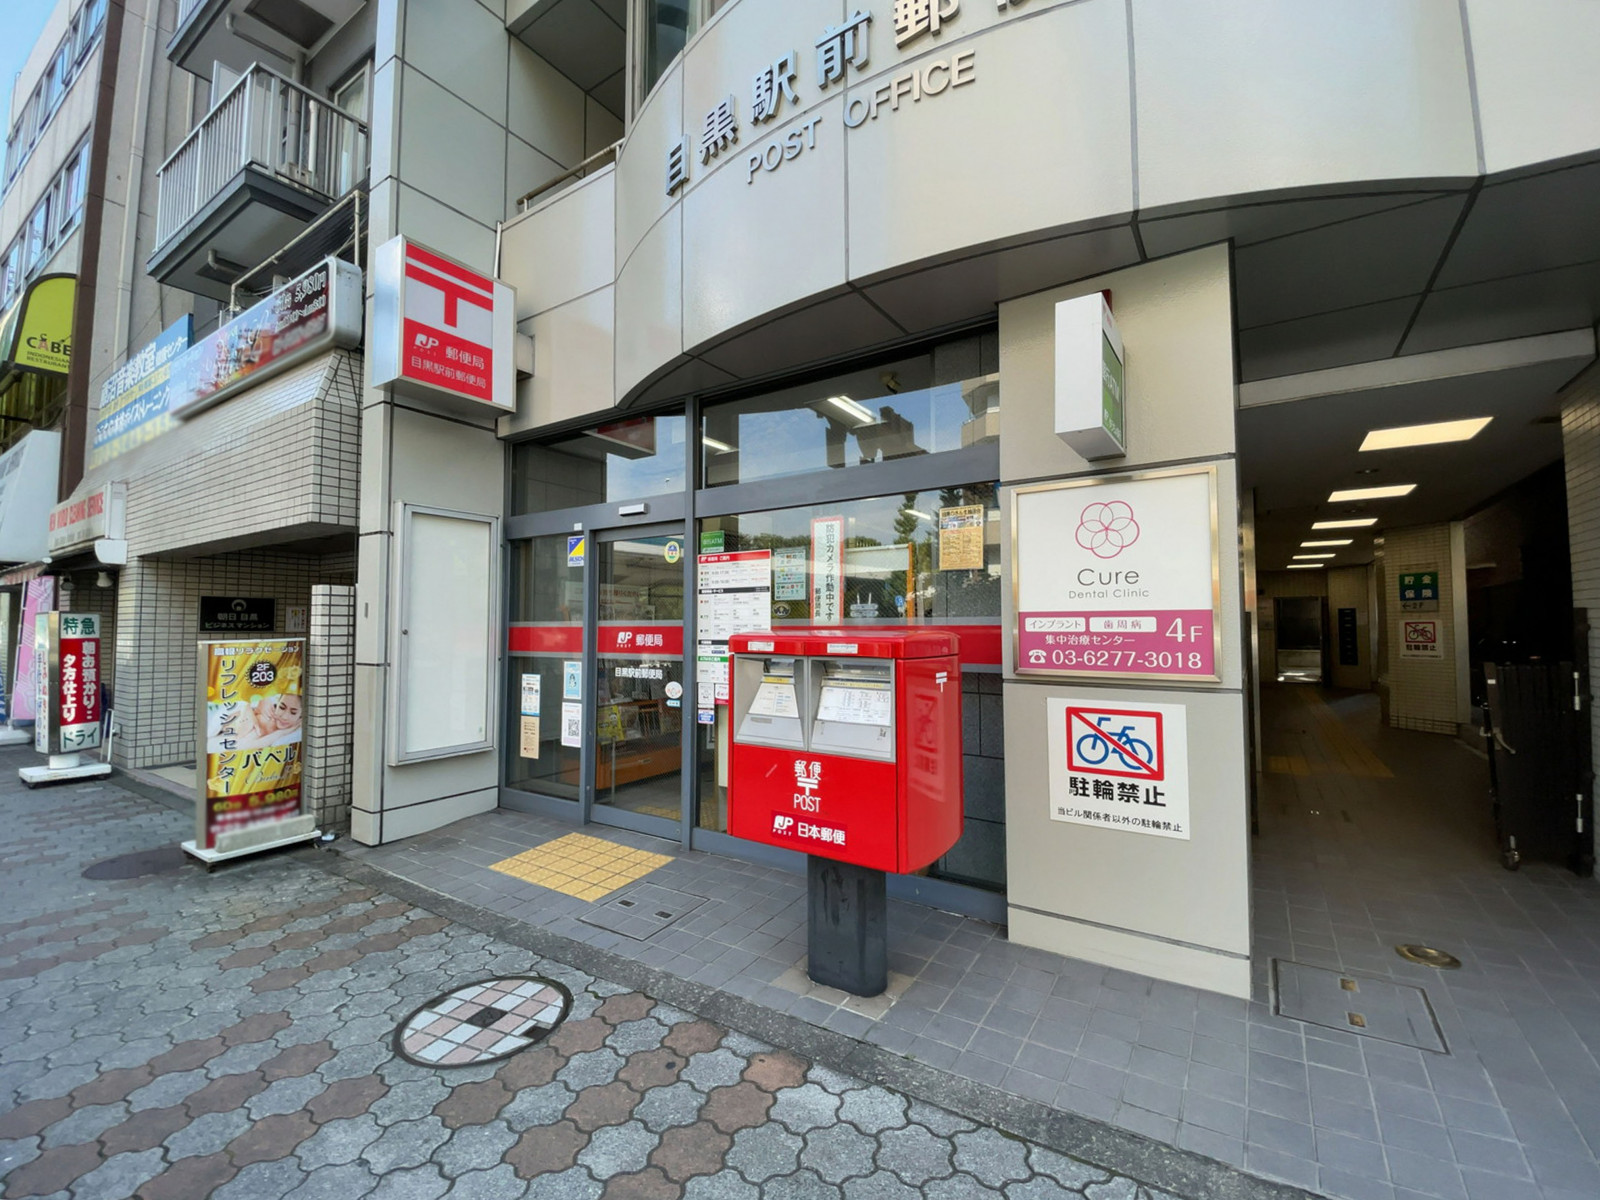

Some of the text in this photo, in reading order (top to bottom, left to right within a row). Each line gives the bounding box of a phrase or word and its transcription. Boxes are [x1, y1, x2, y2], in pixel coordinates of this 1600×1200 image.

[665, 0, 1027, 196] 目黒駅前郵
[747, 49, 976, 184] POST OFFICE
[445, 346, 484, 370] 郵便局
[411, 355, 486, 388] 目黒駅前郵便局
[825, 523, 834, 621] 防犯カメラ作動中です
[1077, 568, 1140, 587] Cure
[1068, 587, 1150, 600] Dental Clinic
[63, 617, 96, 635] 特急
[205, 621, 270, 629] ビジネスマンション
[1028, 618, 1203, 643] インプラント 歯周病 4F
[636, 634, 663, 646] 郵便局
[1045, 634, 1135, 646] 集中治療センター
[1052, 649, 1202, 669] 03-6277-3018
[252, 671, 274, 682] 203
[615, 667, 663, 679] 目黒駅前郵便局
[62, 654, 77, 722] 夕方仕上り
[220, 659, 237, 793] リフレッシュセンター
[63, 727, 97, 749] ドライ
[242, 747, 296, 769] バベル
[794, 760, 822, 780] 郵便
[1068, 776, 1166, 808] 駐輪禁止
[794, 794, 821, 813] POST
[1057, 807, 1183, 833] 当ビル関係者以外の駐輪禁止
[797, 822, 846, 846] 日本郵便
